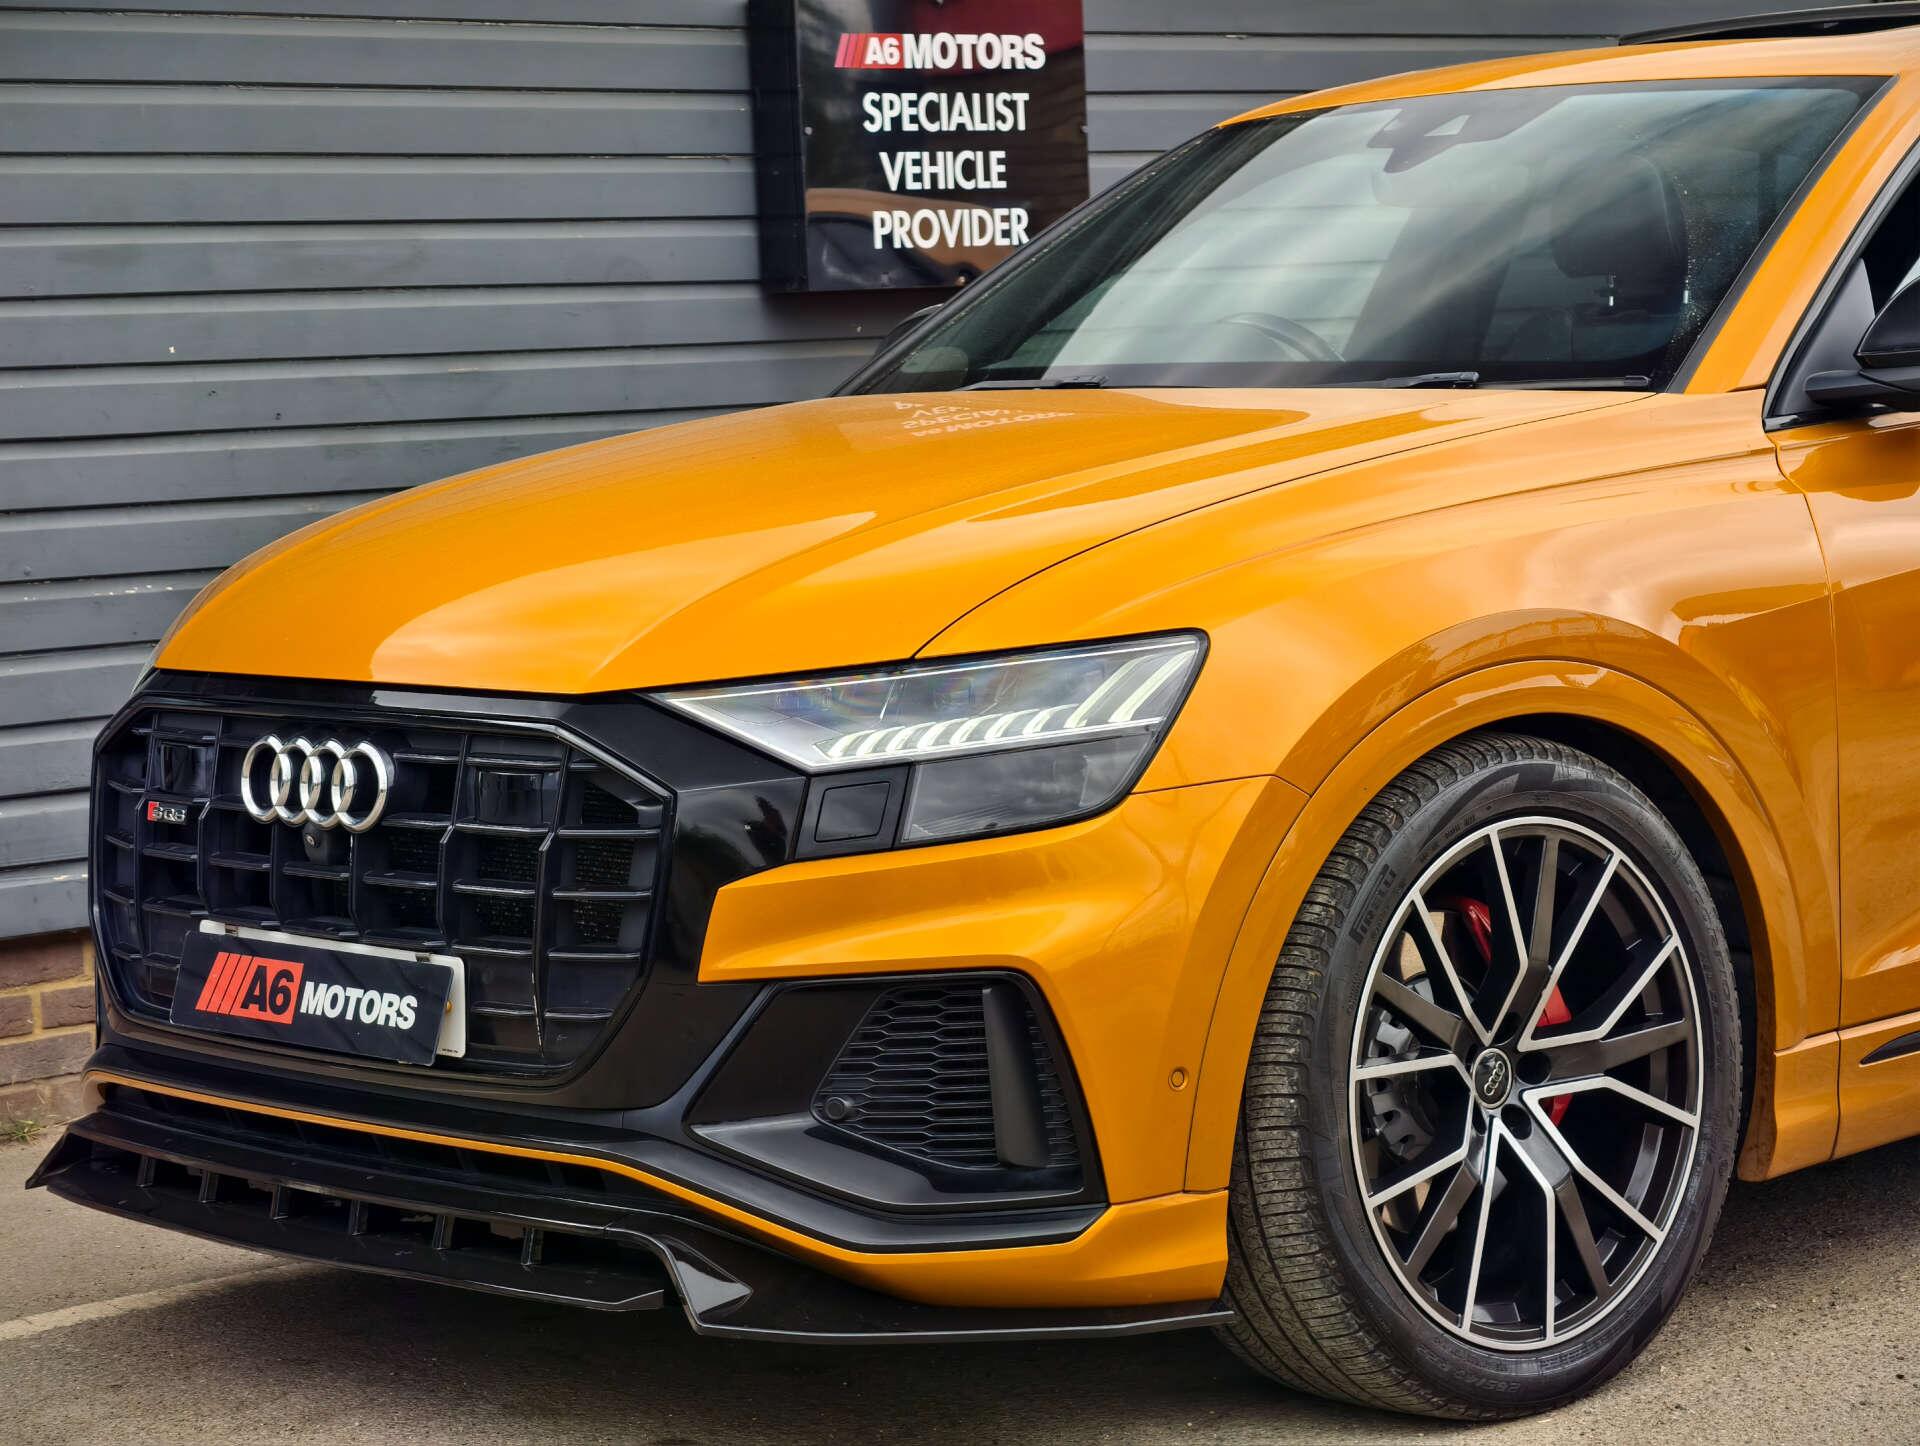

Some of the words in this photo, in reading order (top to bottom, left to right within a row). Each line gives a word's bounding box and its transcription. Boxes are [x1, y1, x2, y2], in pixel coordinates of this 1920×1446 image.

[865, 37, 900, 65] A6
[903, 32, 1046, 70] MOTORS
[862, 92, 1029, 133] SPECIALIST
[879, 150, 1007, 191] VEHICLE
[872, 207, 1030, 249] PROVIDER
[240, 965, 294, 1015] A6
[300, 981, 417, 1030] MOTORS
